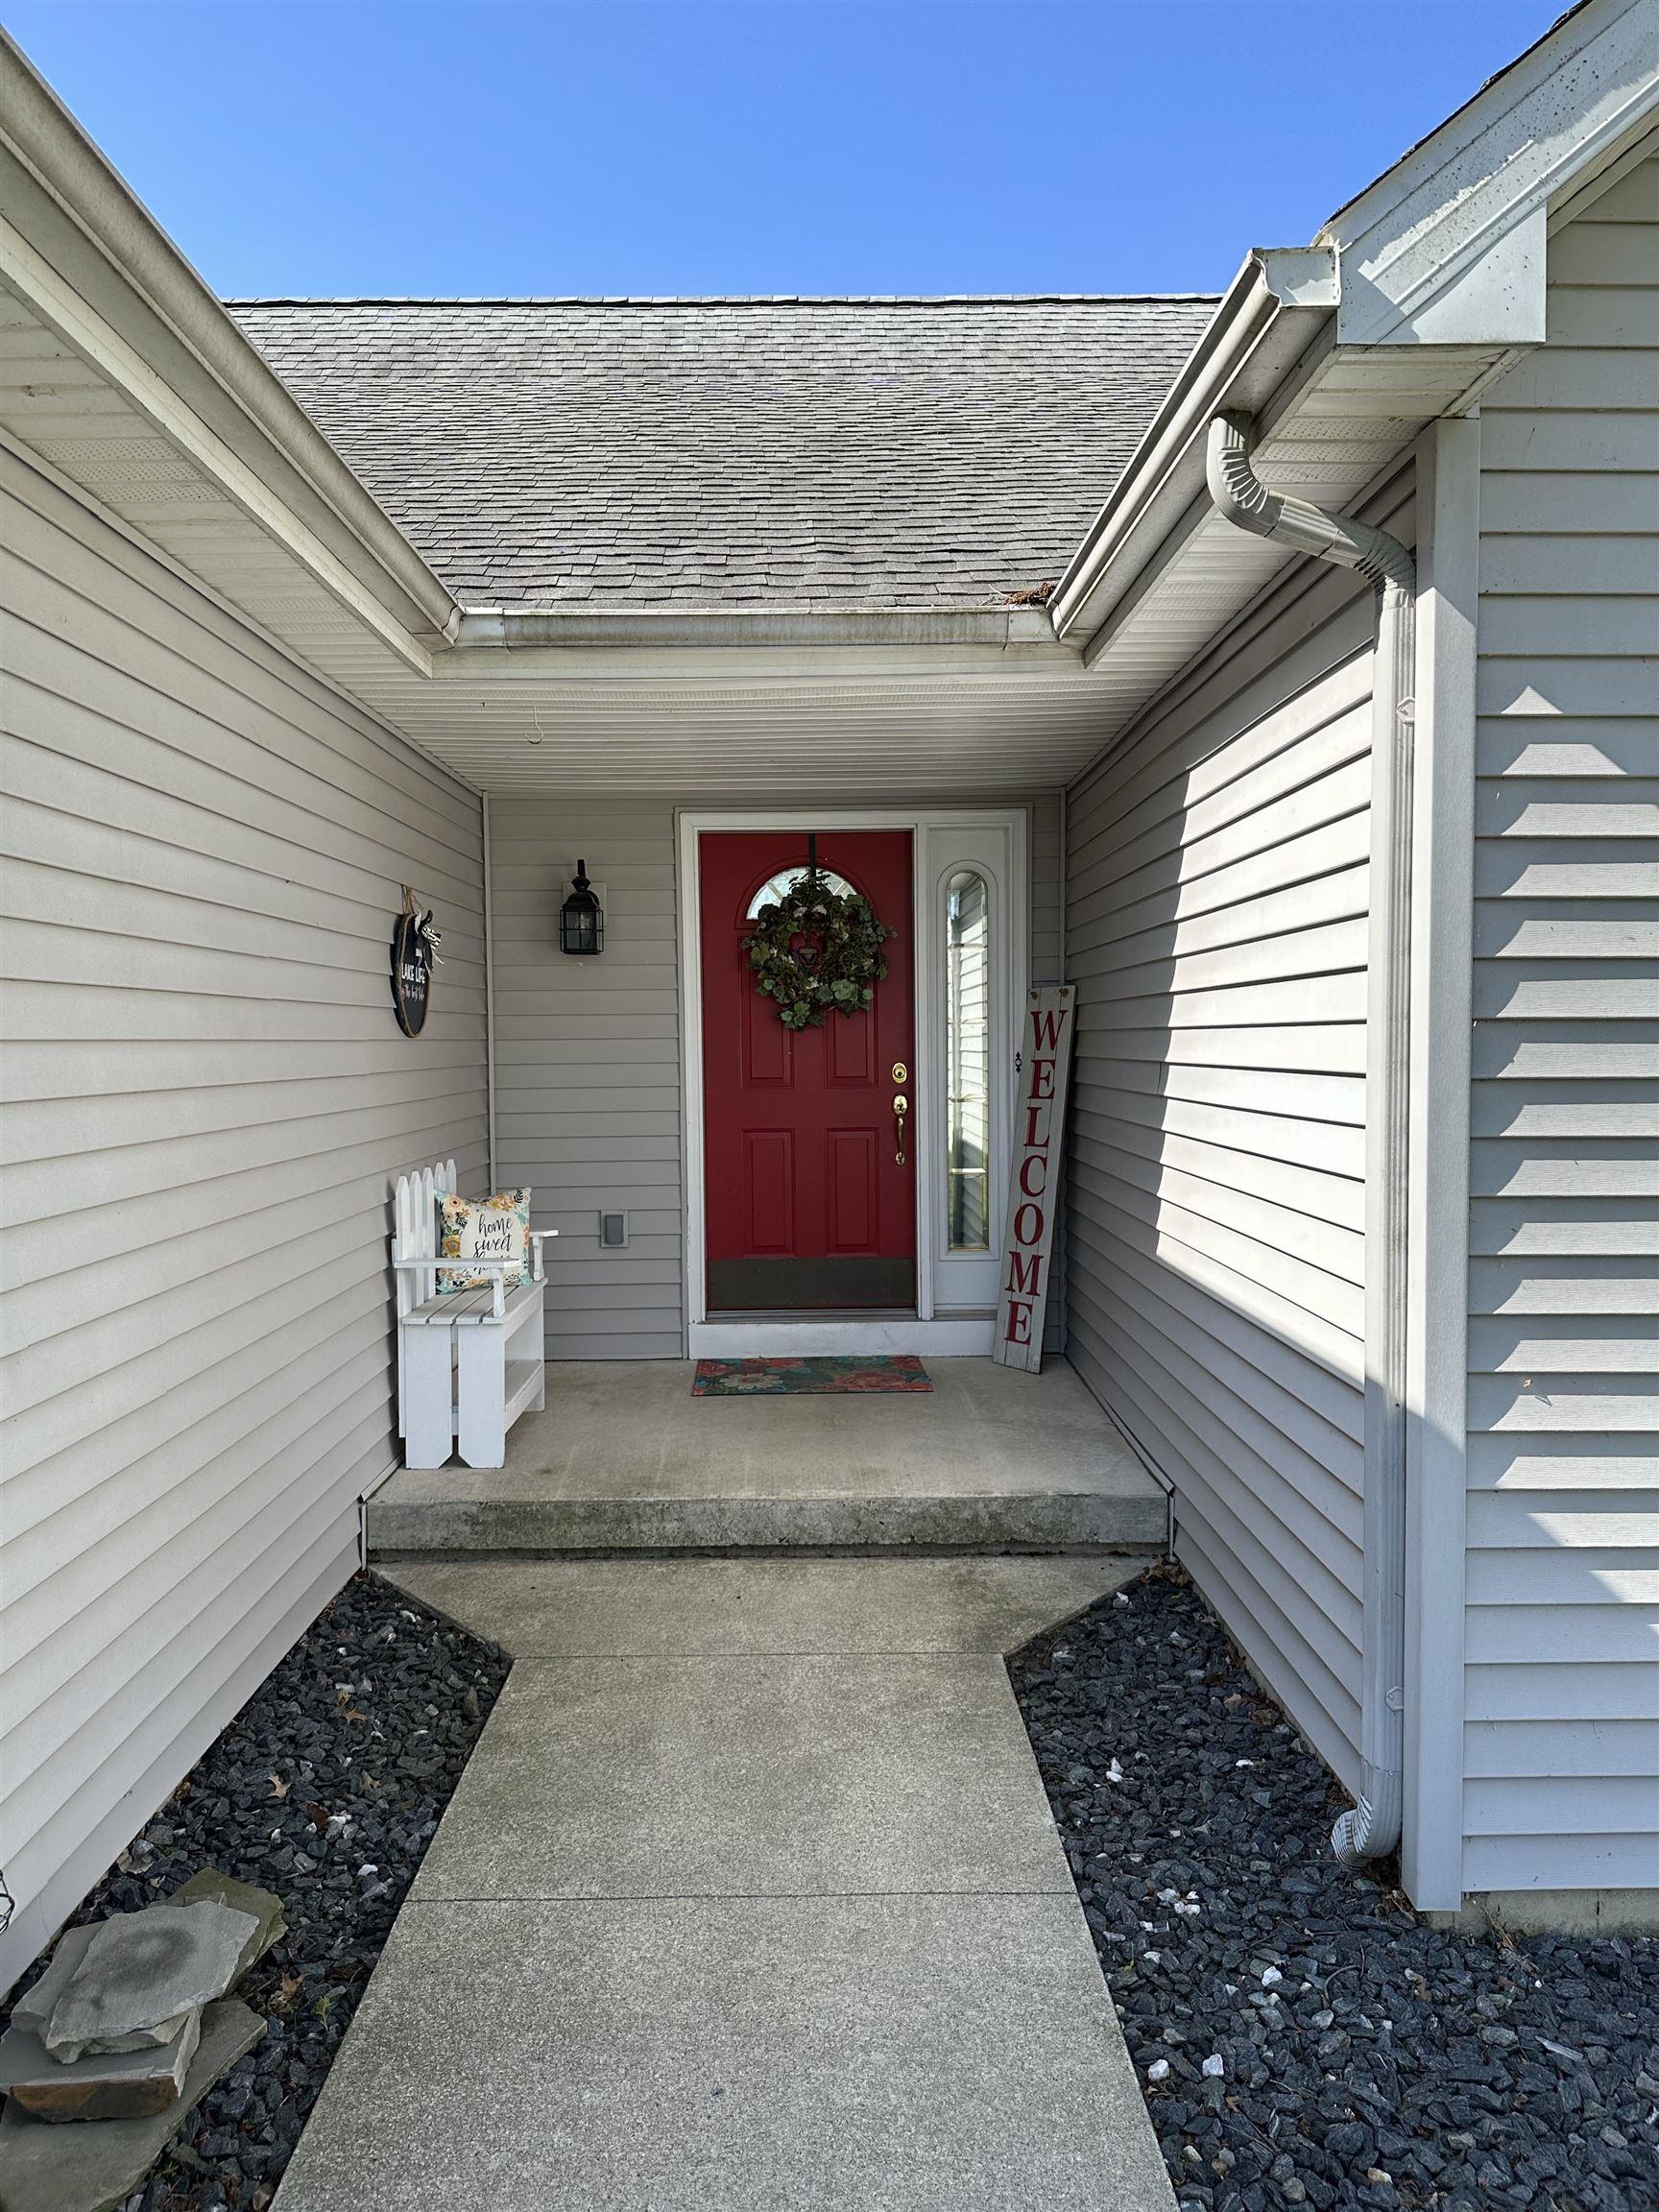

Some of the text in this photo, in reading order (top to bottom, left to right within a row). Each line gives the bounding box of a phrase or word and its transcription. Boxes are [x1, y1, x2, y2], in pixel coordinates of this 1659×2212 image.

[1005, 1009, 1068, 1346] WELCOME
[478, 1213, 513, 1238] home
[473, 1233, 513, 1258] sweet
